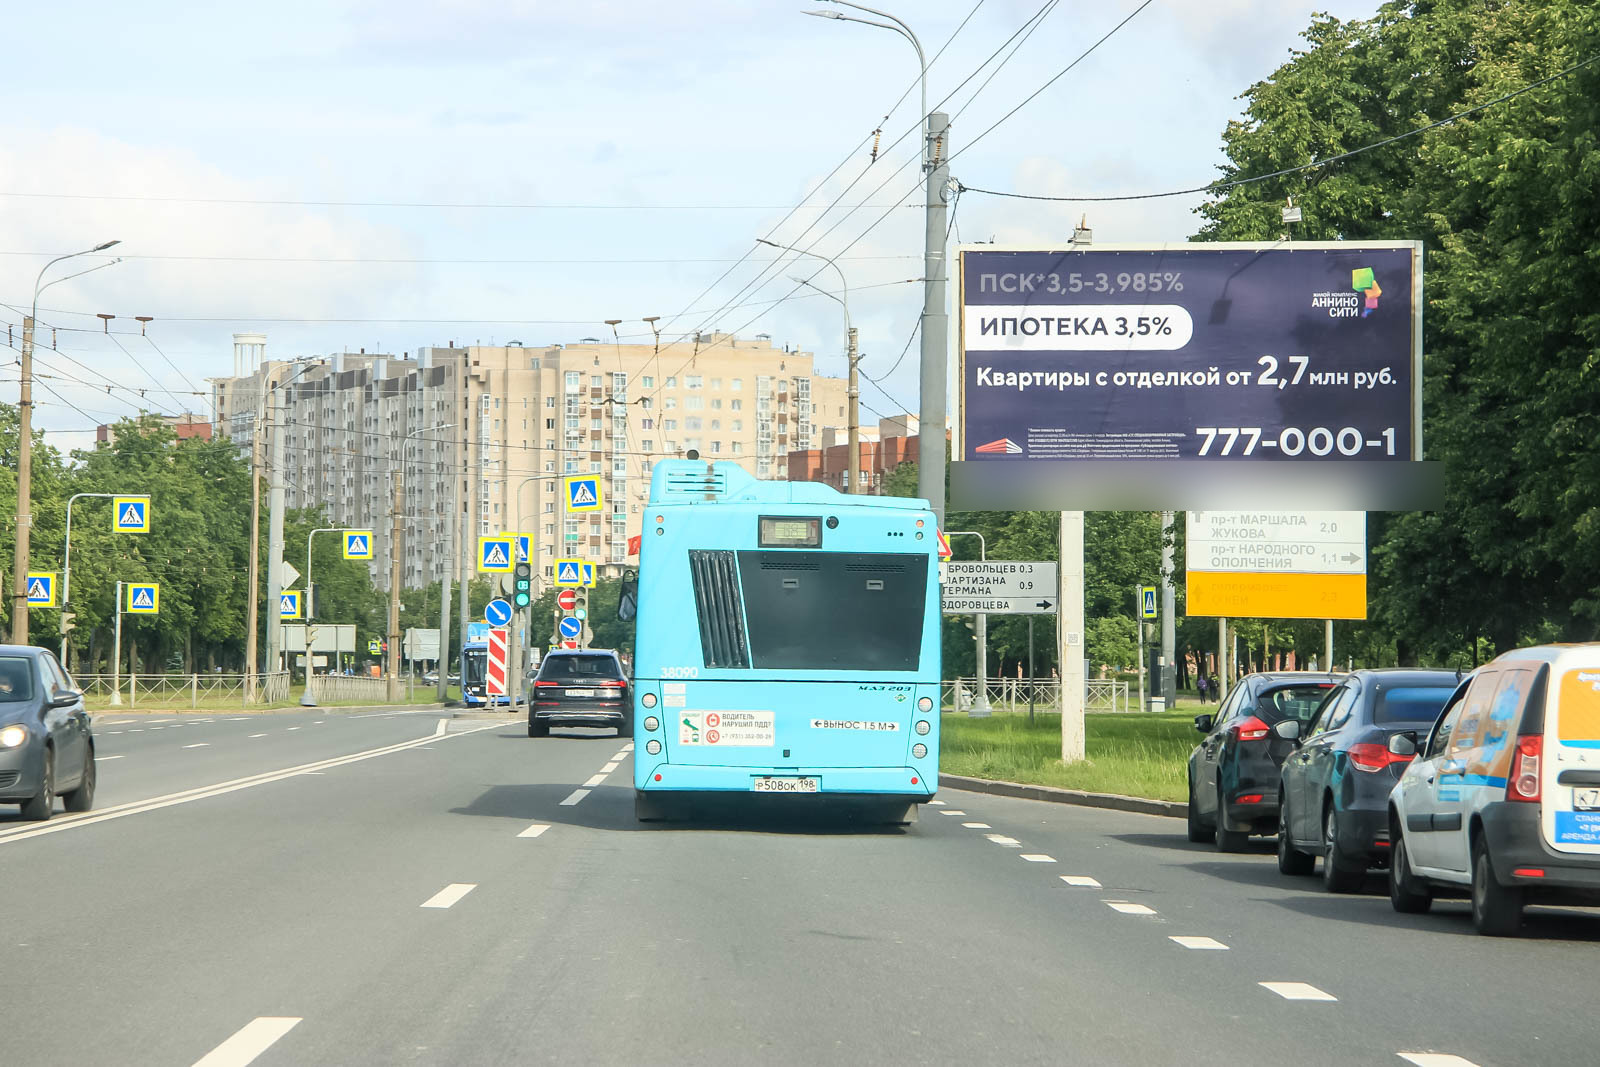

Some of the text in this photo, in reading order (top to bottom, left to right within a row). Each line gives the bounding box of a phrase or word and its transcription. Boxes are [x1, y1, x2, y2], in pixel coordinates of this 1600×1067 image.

[1311, 297, 1359, 307] АННИНО
[1329, 307, 1358, 317] СИТИ
[980, 317, 1172, 338] ИПОТЕКА 3,5%
[976, 355, 1397, 391] Квартиры с отделкой от 2,7 млн руб.
[1196, 426, 1396, 456] 777-000-1
[1211, 515, 1307, 527] пр-т МАРШАЛА
[1211, 528, 1266, 539] ЖУКОВА
[1320, 522, 1337, 534] 2,0
[1211, 544, 1315, 556] пр-т НАРОДНОГО
[1211, 557, 1292, 568] ОПОЛЧЕНИЯ
[1321, 553, 1337, 565] 1,1
[1019, 564, 1033, 574] 0.3
[942, 586, 992, 595] ГЕРМАНА
[1019, 581, 1033, 590] 0.9
[942, 600, 1010, 610] ЗДОРОВЦЕВА
[660, 666, 698, 679] 38090
[823, 720, 887, 730] ВЫНОС 1.5 М
[799, 780, 814, 788] 198
